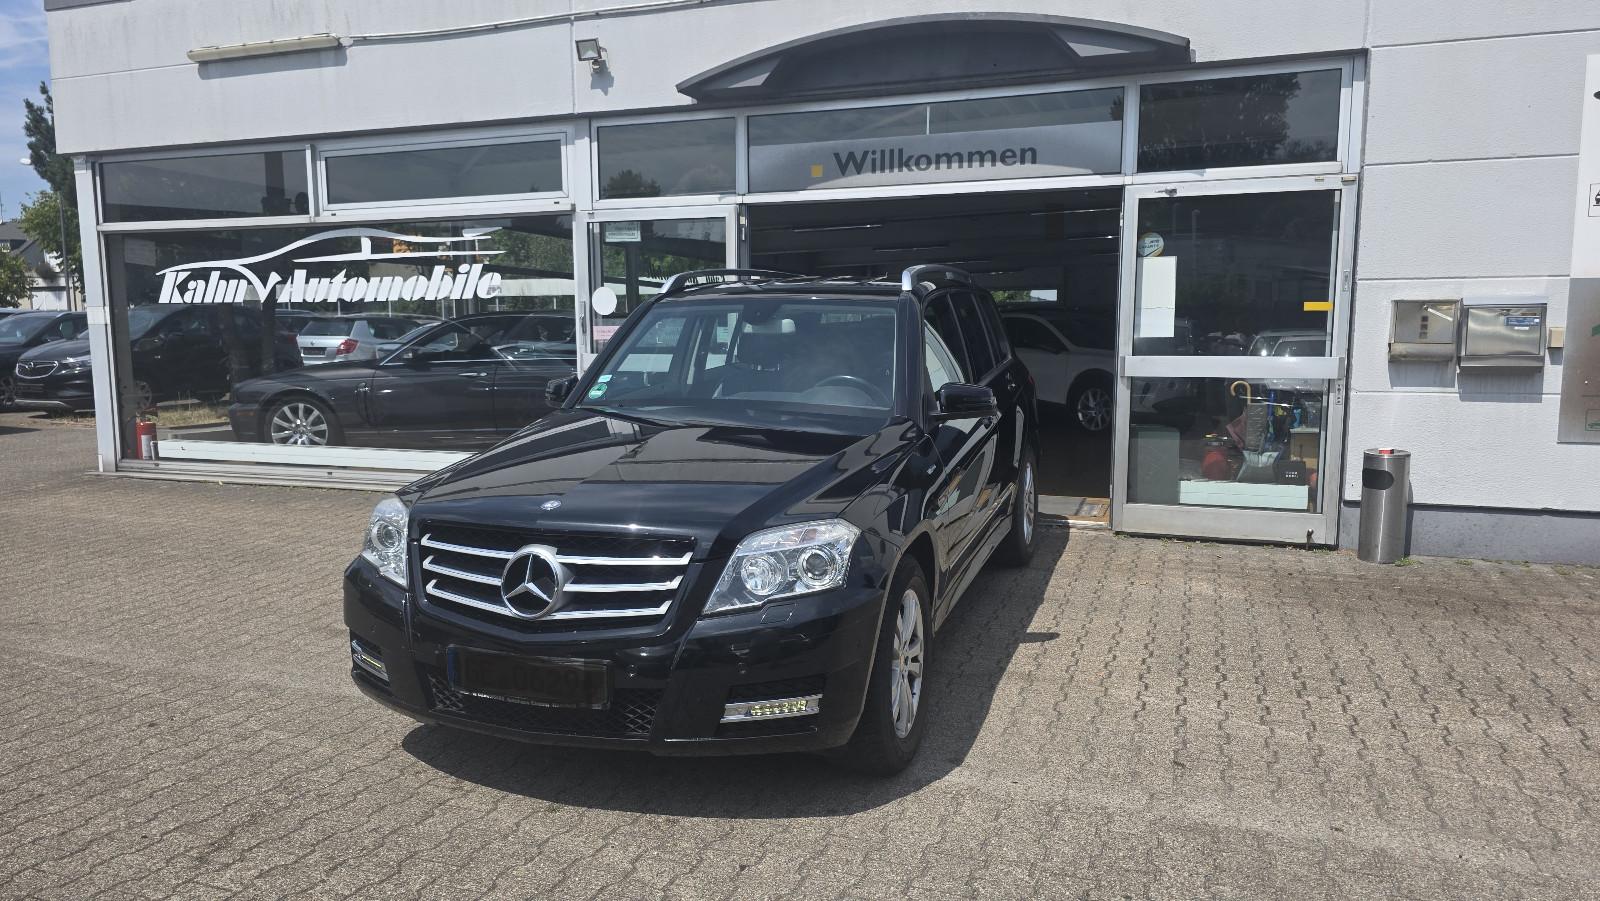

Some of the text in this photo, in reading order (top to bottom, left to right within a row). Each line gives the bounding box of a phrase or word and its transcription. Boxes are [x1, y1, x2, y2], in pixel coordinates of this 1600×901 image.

[833, 147, 1037, 176] Willkommen
[158, 263, 502, 304] Kahn Automobile
